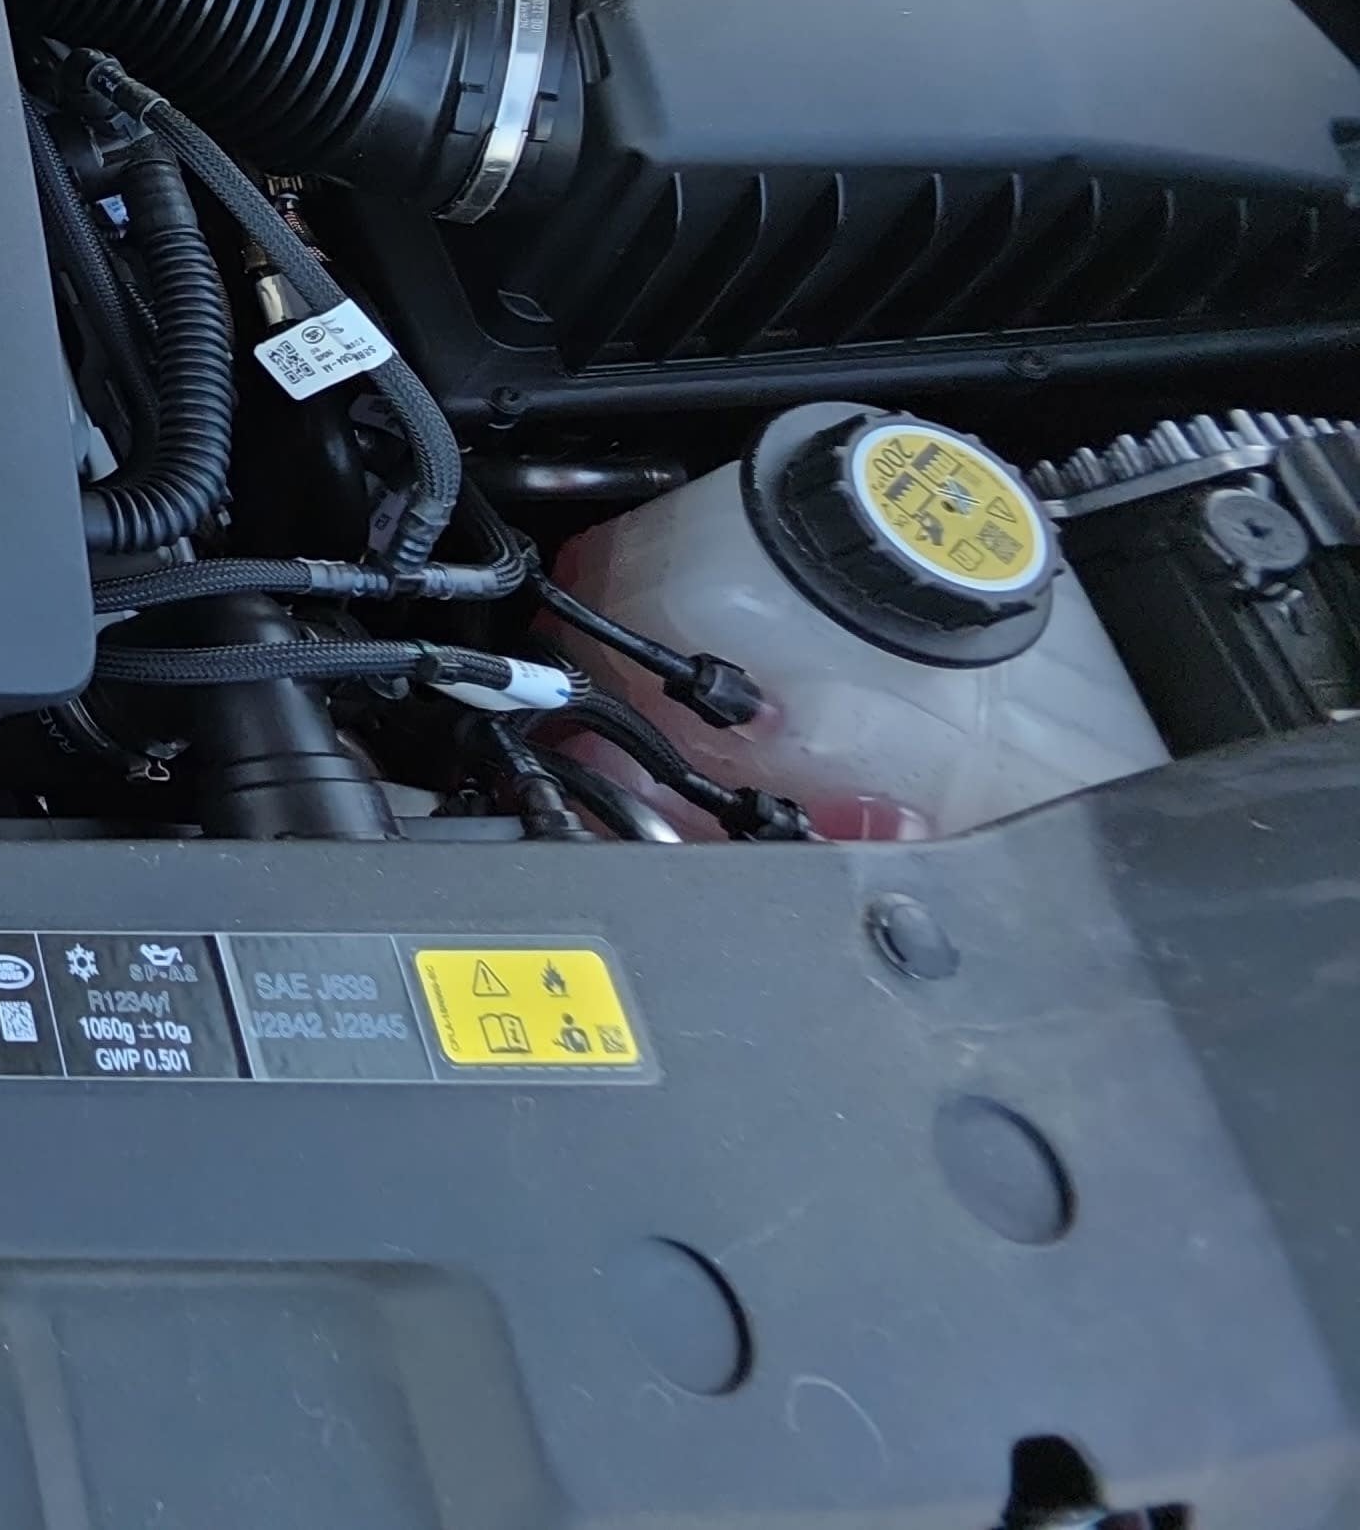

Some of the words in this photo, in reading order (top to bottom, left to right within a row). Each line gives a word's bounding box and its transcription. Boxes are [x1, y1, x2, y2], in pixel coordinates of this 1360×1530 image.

[873, 439, 914, 478] 200
[254, 972, 312, 1000] SAE
[316, 973, 378, 1000] J639
[79, 1016, 136, 1045] 1060g
[252, 1010, 326, 1038] J2842
[331, 1011, 408, 1039] J2845
[95, 1048, 141, 1071] GWP
[143, 1048, 191, 1071] 0.501
